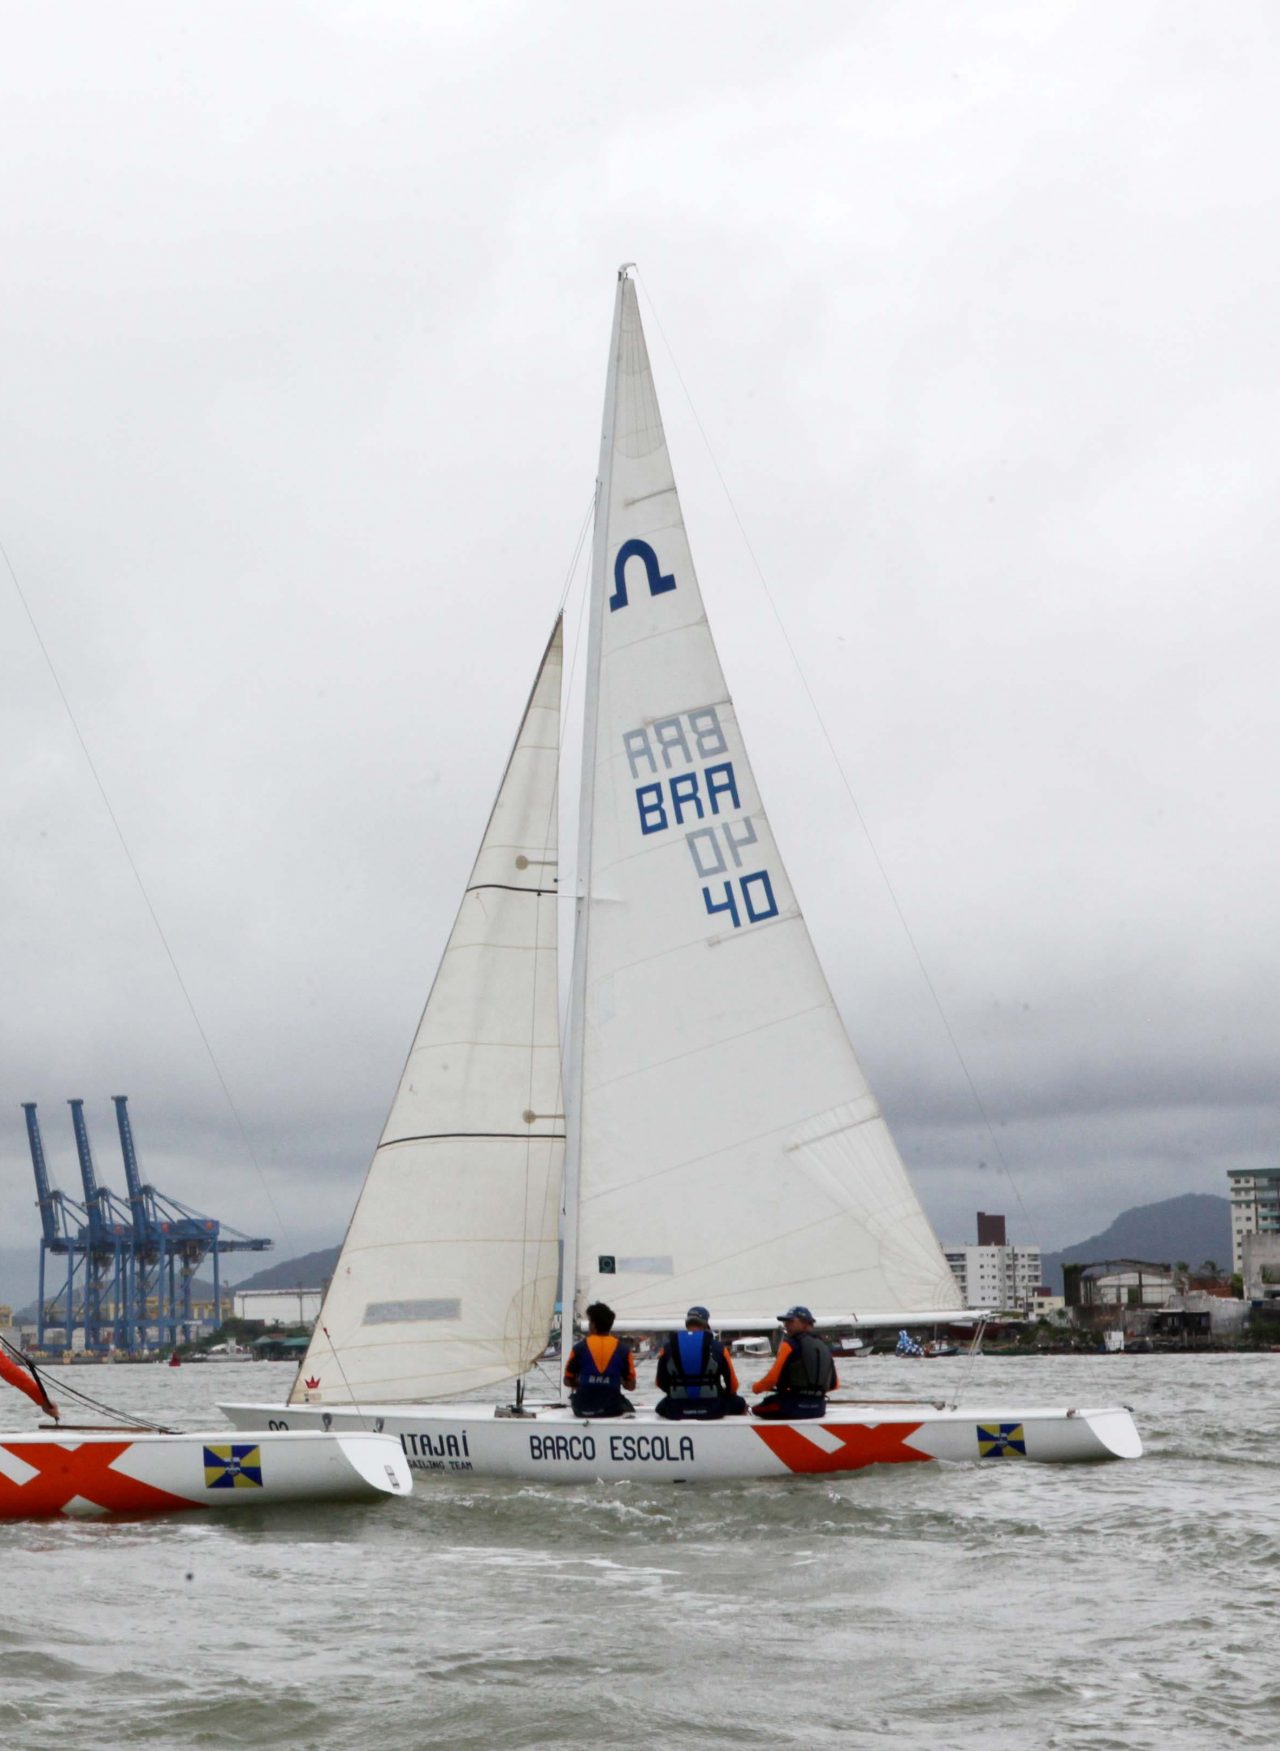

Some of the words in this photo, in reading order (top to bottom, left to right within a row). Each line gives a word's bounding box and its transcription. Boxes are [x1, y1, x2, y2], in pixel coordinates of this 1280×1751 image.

[636, 761, 741, 836] BRA
[702, 869, 779, 929] 40
[400, 1430, 469, 1458] ITAJAÍ
[530, 1435, 596, 1462] BARCO
[611, 1436, 694, 1461] ESCOLA
[448, 1461, 473, 1471] TEAM
